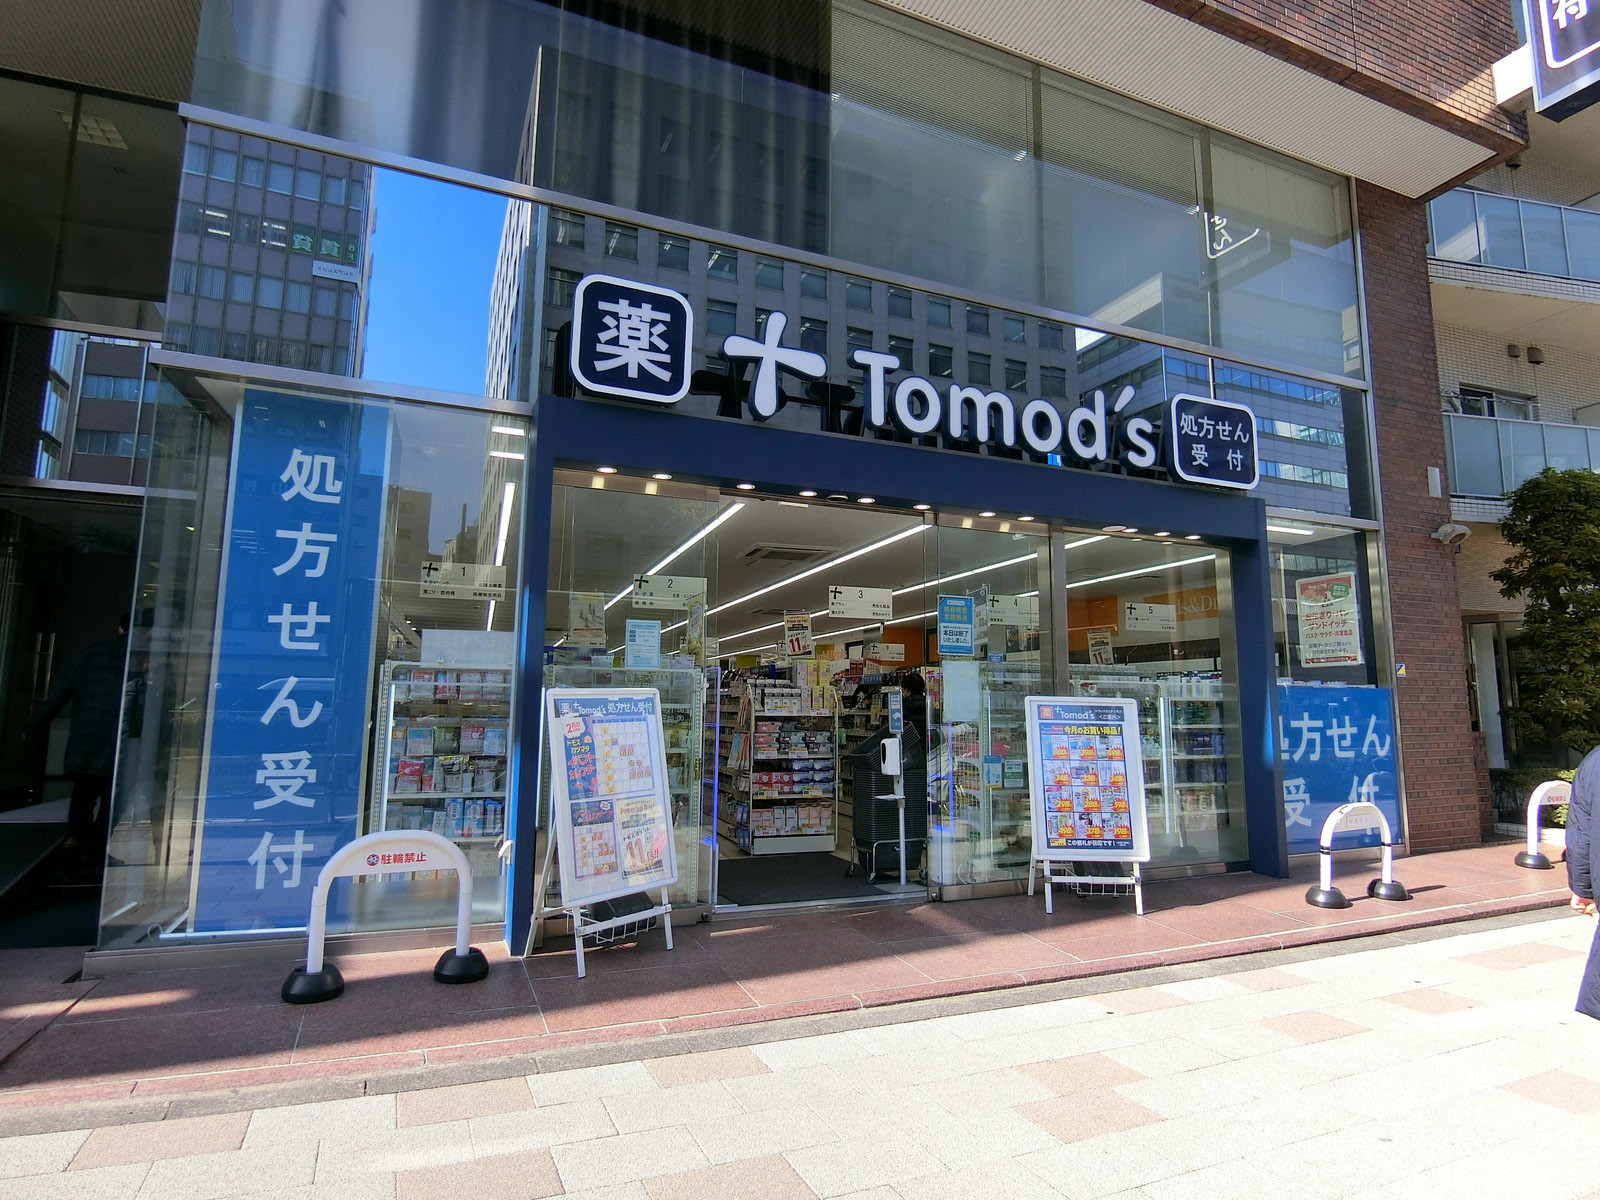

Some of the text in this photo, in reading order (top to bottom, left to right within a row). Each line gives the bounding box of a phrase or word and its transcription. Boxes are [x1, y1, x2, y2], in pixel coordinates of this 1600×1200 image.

[594, 299, 672, 383] 薬
[853, 349, 1157, 468] Tomod's
[1179, 412, 1250, 444] 処方せん
[461, 566, 466, 577] 1
[667, 579, 674, 589] 2
[858, 589, 864, 599] 3
[1013, 598, 1018, 607] 4
[1148, 606, 1154, 615] 5
[1308, 619, 1348, 630] サンドイッチ
[943, 629, 969, 637] 本日は終了
[246, 447, 343, 890] 処方せん受付
[577, 705, 606, 715] Tomod's
[607, 701, 653, 714] 処方せん受付
[1060, 710, 1095, 720] Tomod's
[380, 852, 427, 865] 駐輪禁止
